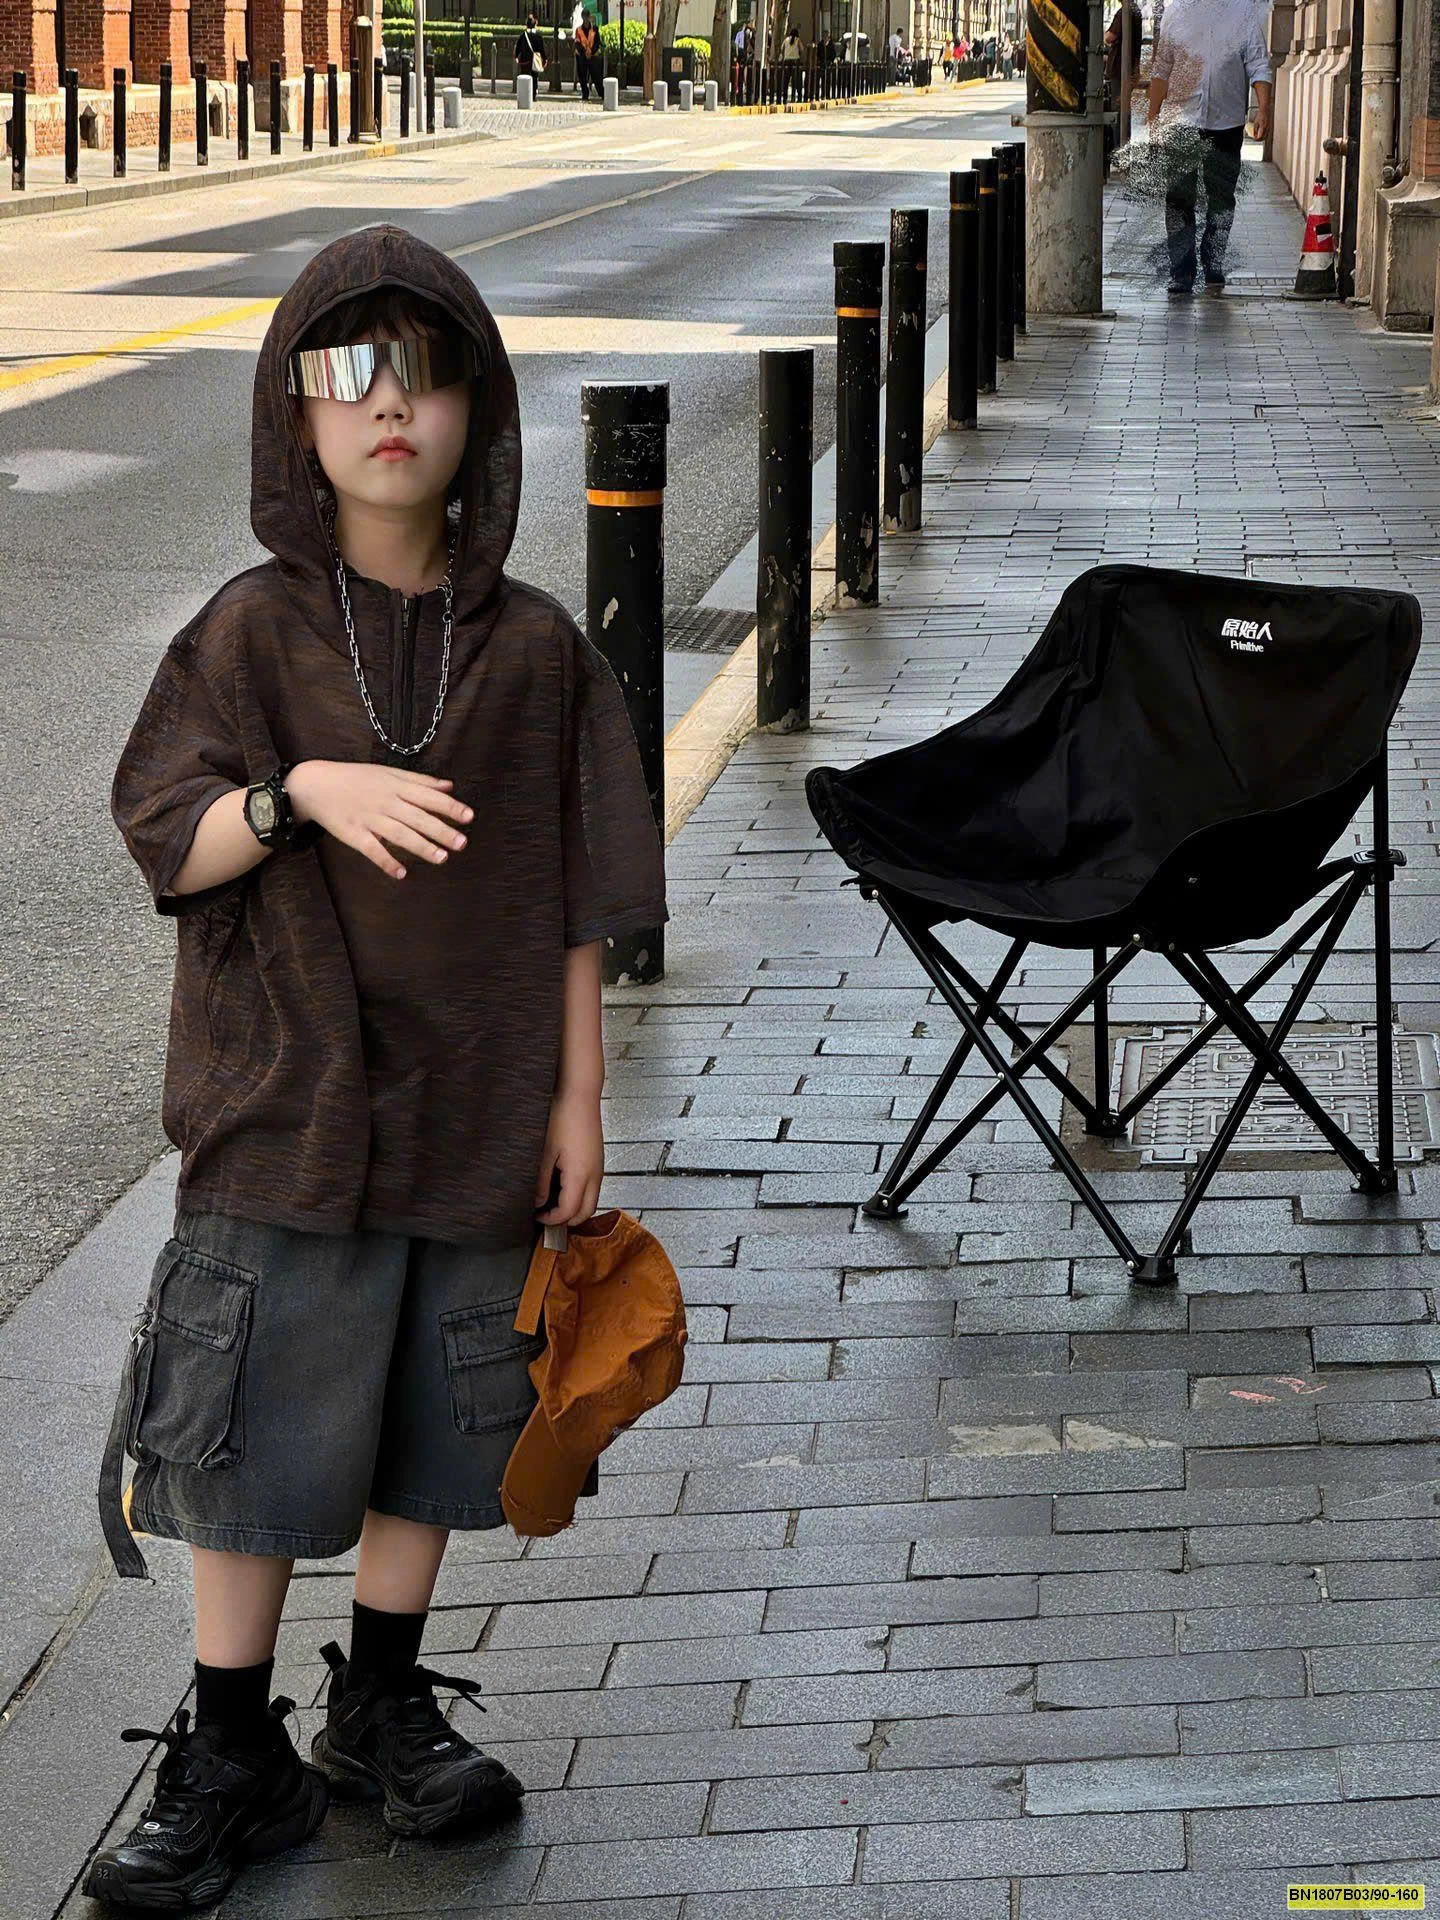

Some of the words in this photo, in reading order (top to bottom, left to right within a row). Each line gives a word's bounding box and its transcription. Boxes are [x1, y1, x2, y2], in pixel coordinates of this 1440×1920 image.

[1221, 618, 1273, 641] 原始人
[1230, 640, 1264, 653] Primitive
